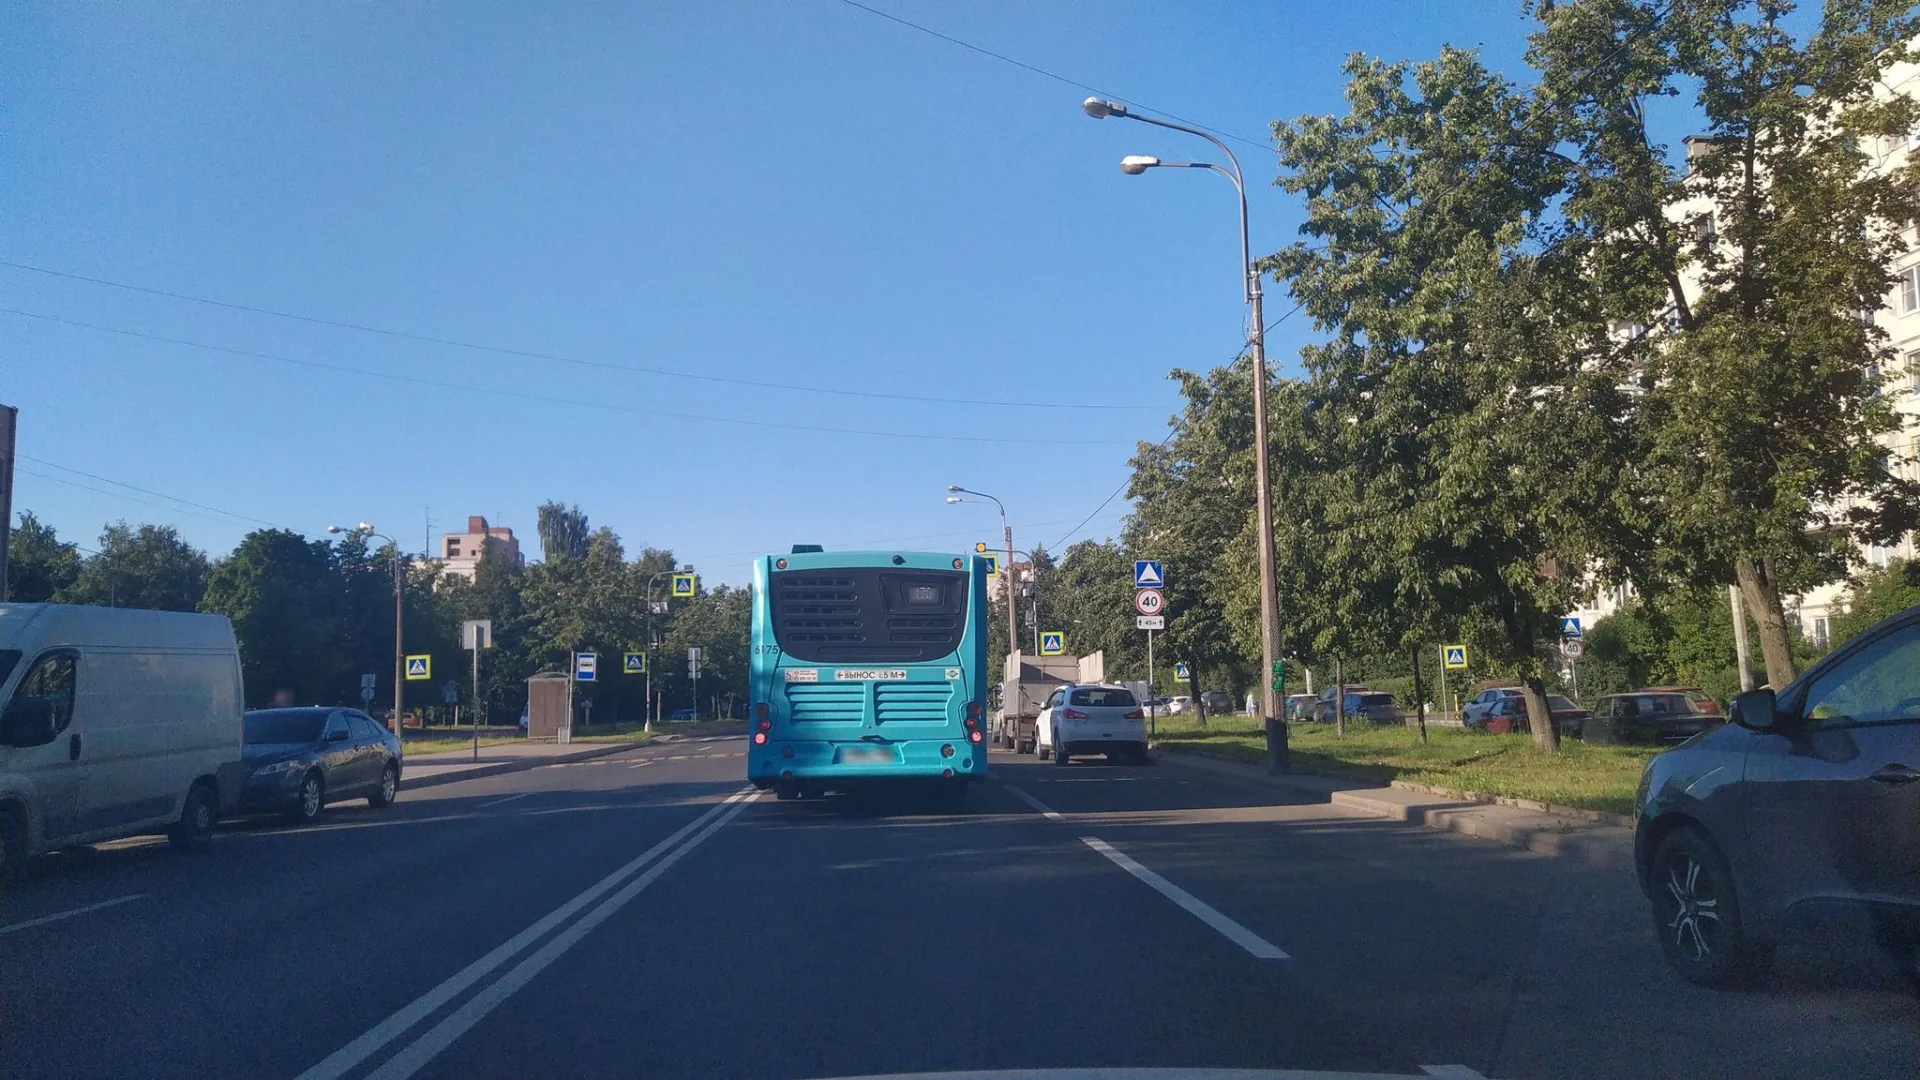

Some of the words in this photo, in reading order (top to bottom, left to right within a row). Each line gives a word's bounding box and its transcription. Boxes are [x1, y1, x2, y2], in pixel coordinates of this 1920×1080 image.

[1142, 596, 1158, 607] 40
[755, 645, 779, 655] 6175
[1567, 644, 1579, 654] 40
[844, 671, 876, 679] ВЫНОС
